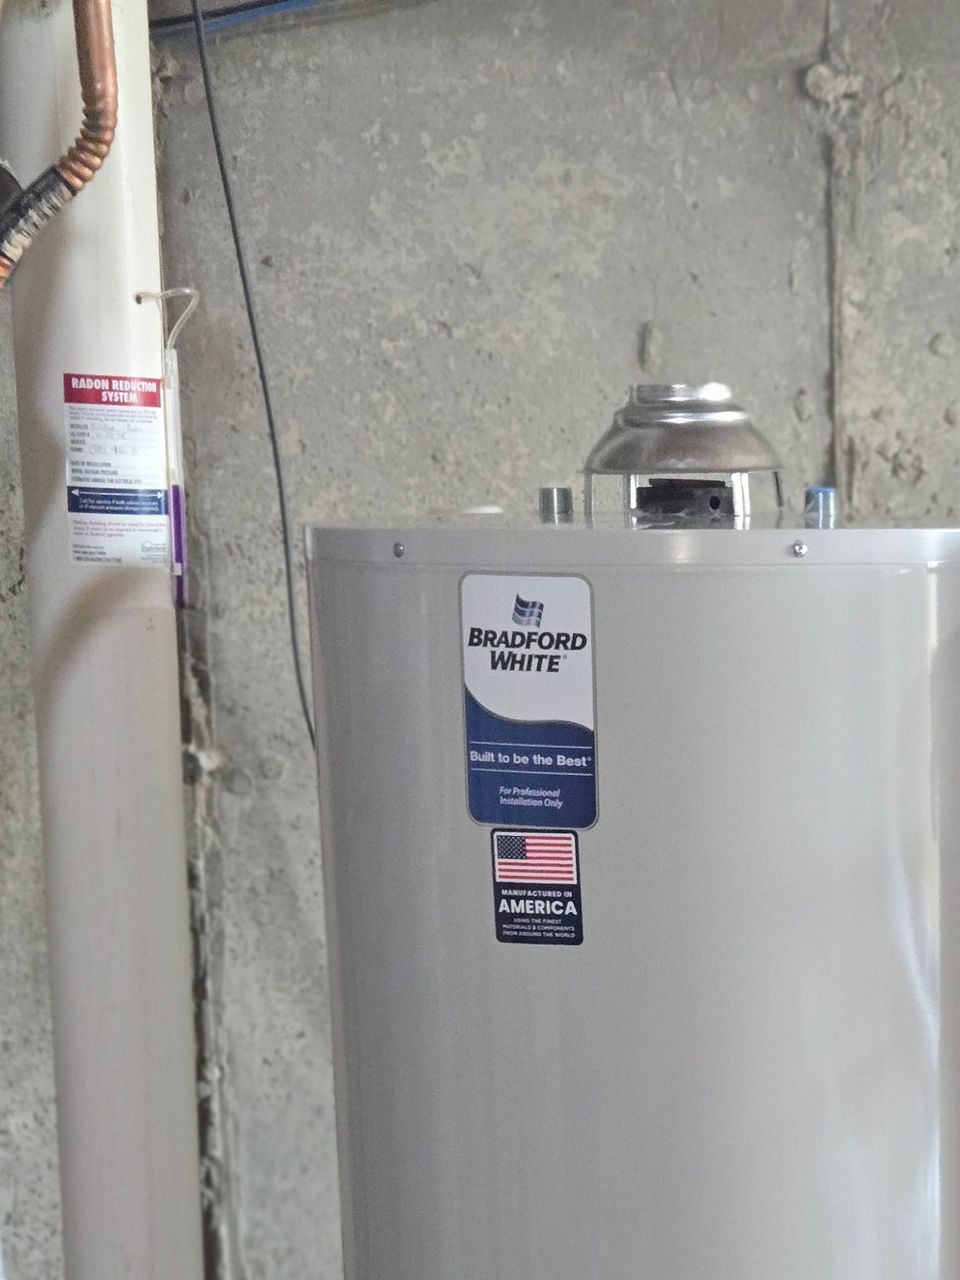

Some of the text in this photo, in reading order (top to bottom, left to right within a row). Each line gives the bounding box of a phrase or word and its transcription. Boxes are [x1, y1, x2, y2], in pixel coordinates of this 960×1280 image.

[72, 377, 156, 392] RADON REDUCTION
[102, 391, 138, 403] SYSTEM
[468, 627, 588, 650] BRADFORD
[490, 650, 561, 672] WHITE
[470, 751, 495, 762] Built
[498, 752, 510, 763] to
[513, 753, 529, 764] be
[533, 754, 553, 765] the
[500, 786, 560, 798] For Professional
[500, 796, 563, 810] Installation Only
[502, 889, 562, 897] MANUFACTURED
[499, 899, 578, 915] AMERICA
